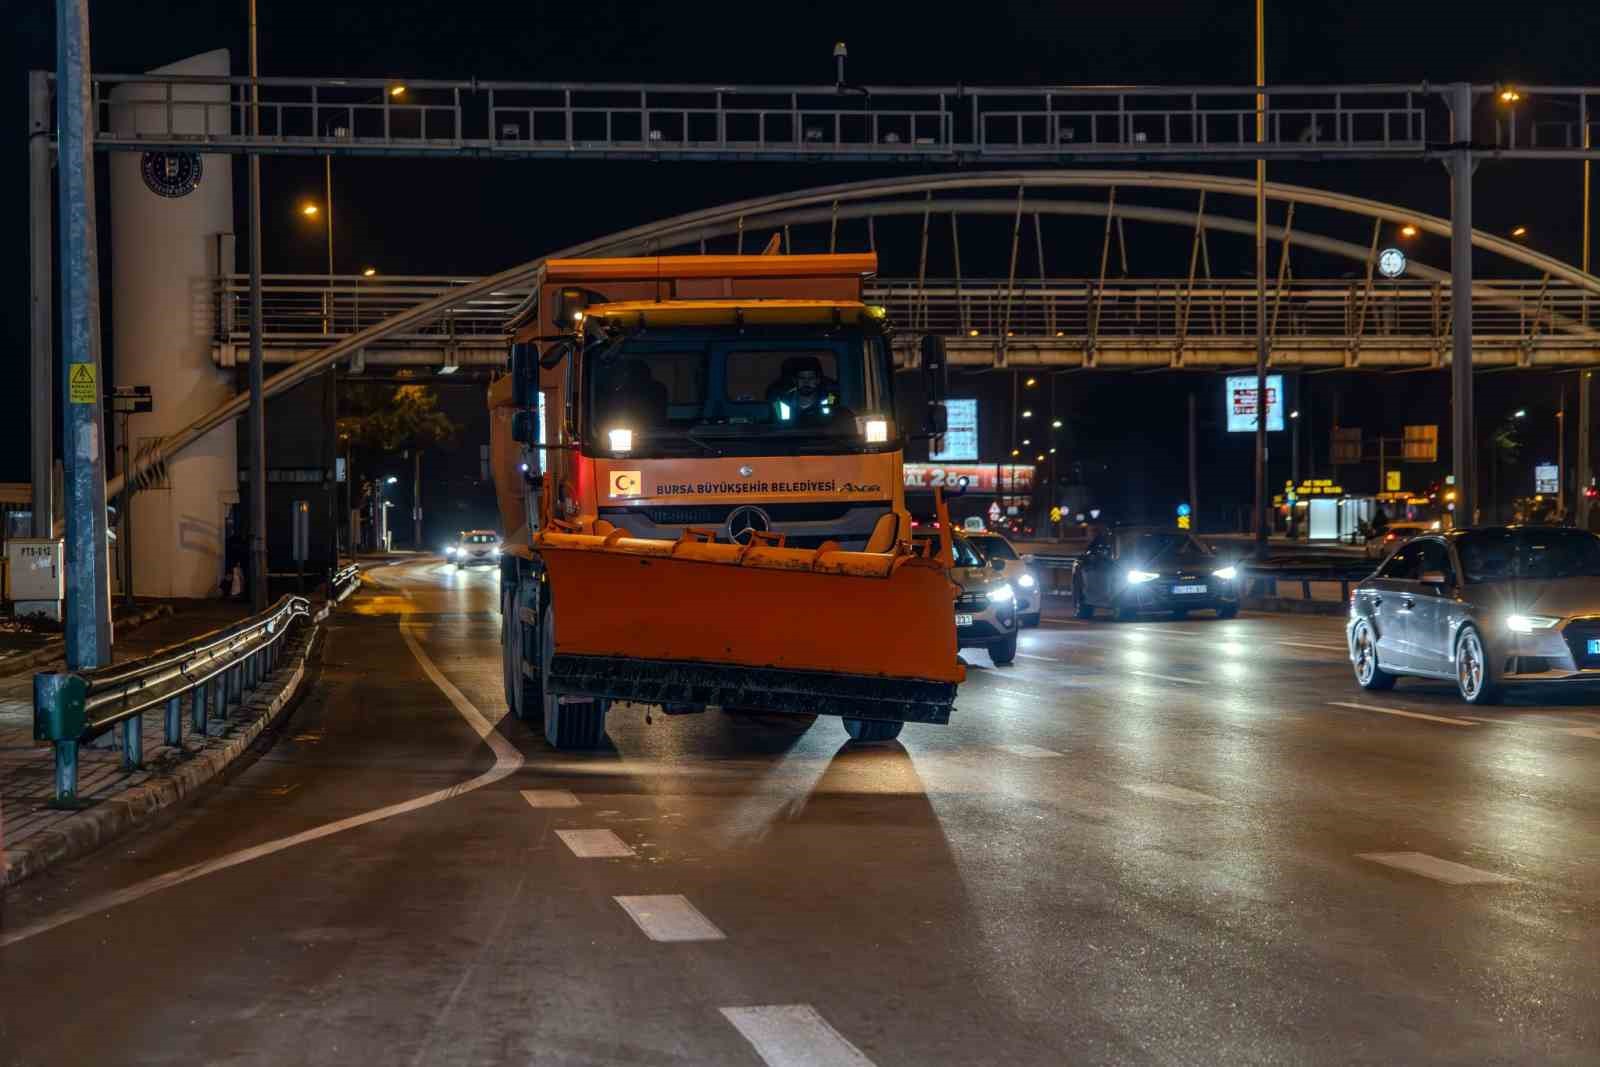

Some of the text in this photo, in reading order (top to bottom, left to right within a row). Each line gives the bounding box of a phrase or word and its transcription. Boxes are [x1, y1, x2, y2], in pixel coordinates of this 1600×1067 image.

[656, 479, 835, 494] BURSA BÜYÜKŞEHİR BELEDİYESİ
